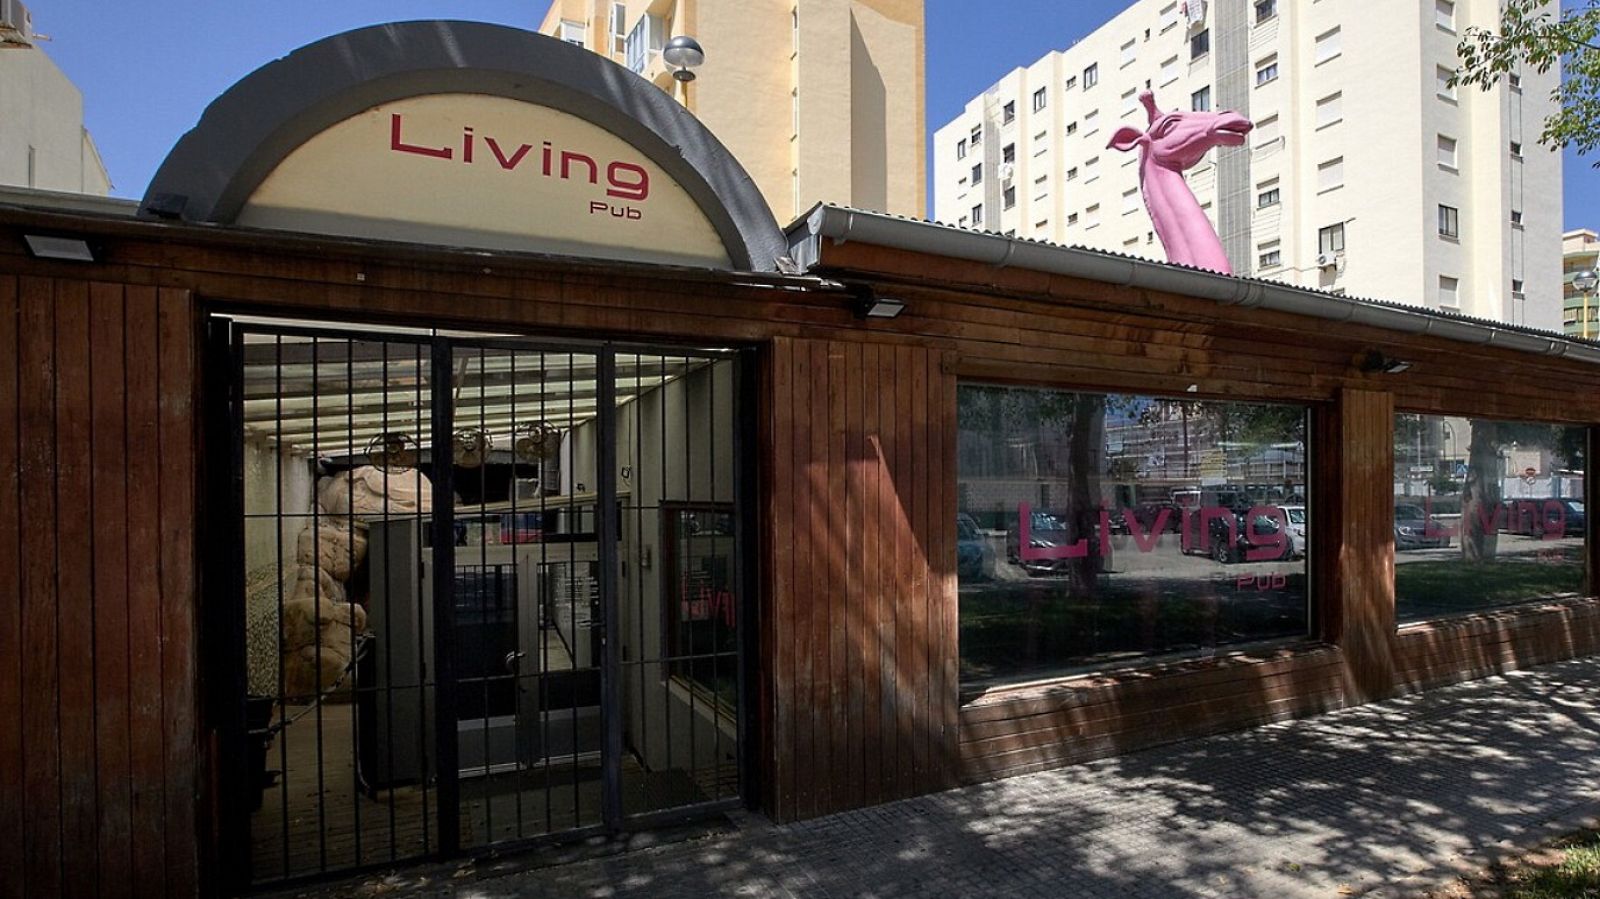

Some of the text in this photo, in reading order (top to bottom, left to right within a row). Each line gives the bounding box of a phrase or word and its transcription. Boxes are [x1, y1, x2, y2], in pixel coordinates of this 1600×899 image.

[391, 113, 649, 201] Living
[590, 201, 642, 220] Pub
[1017, 500, 1287, 561] Living
